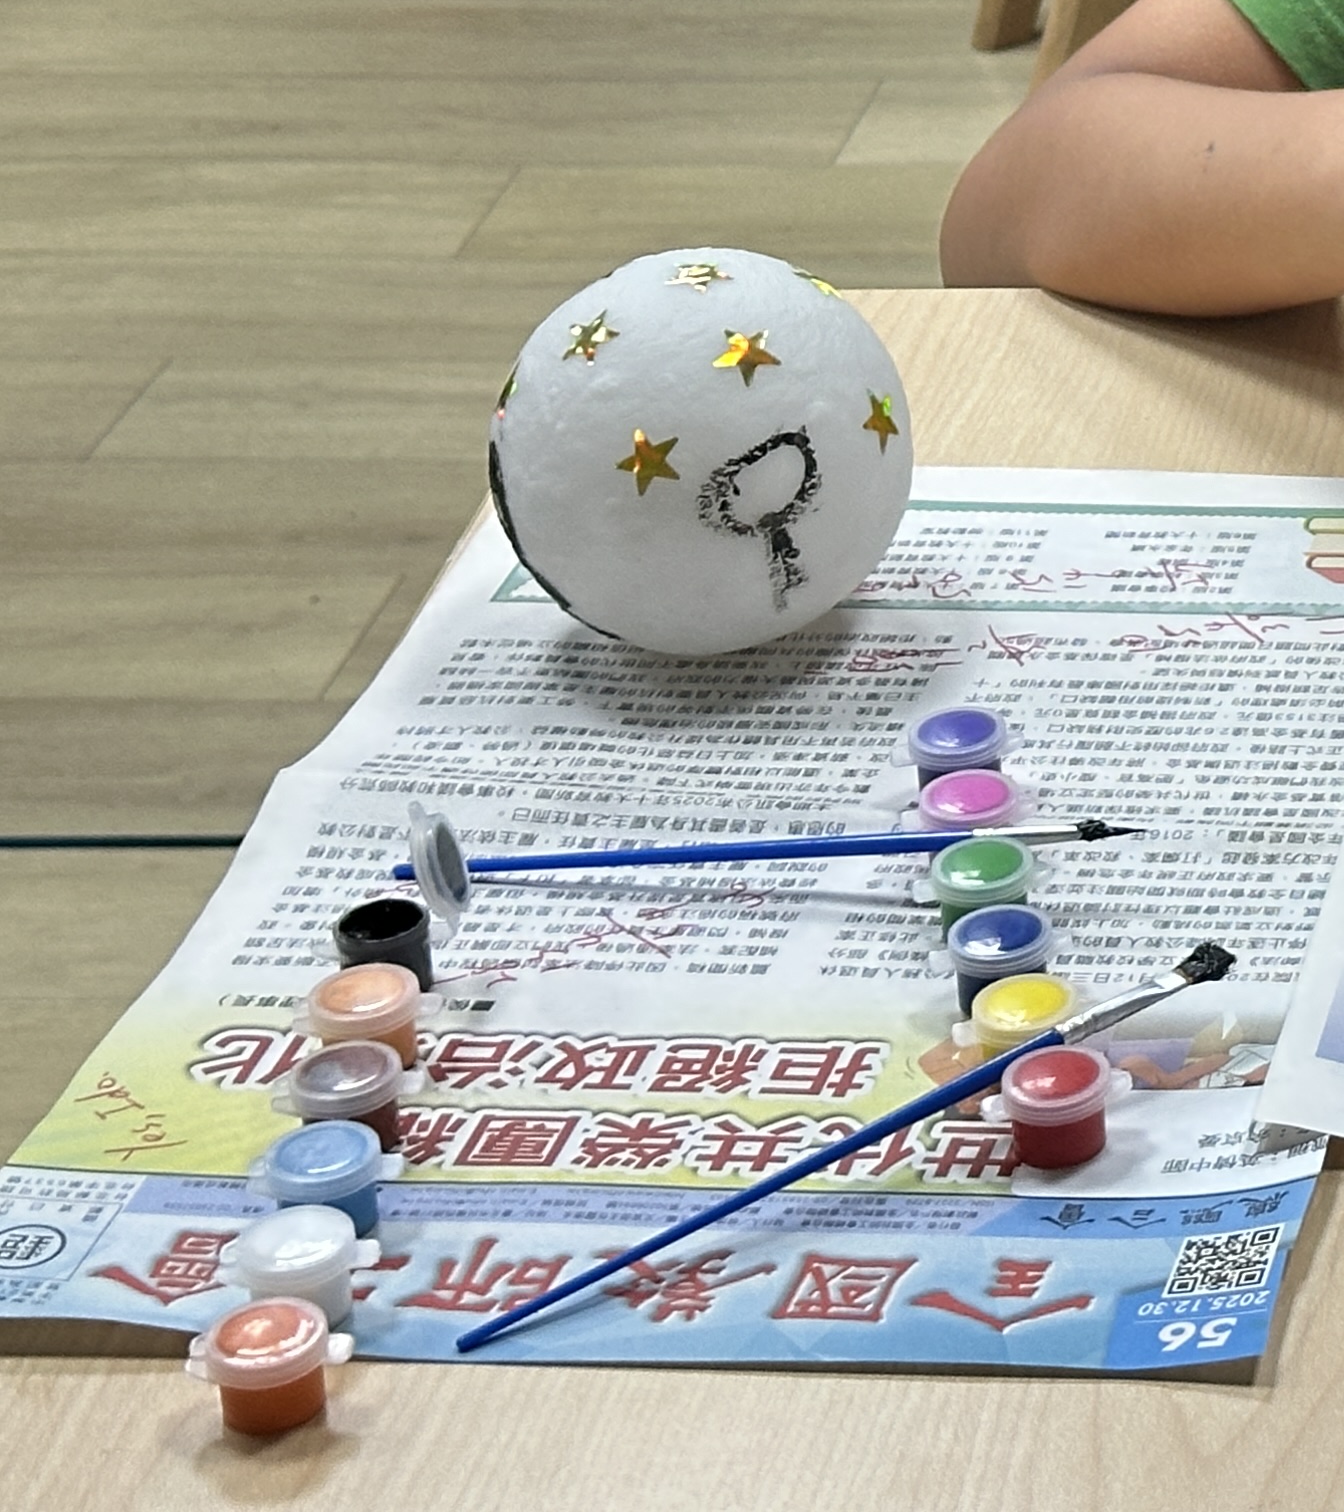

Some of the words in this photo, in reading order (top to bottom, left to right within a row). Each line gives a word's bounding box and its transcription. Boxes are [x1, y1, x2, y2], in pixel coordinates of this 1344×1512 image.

[198, 1031, 870, 1099] 拒絕政治化
[1137, 1289, 1270, 1316] 2025.12.30
[1157, 1316, 1237, 1351] 56
